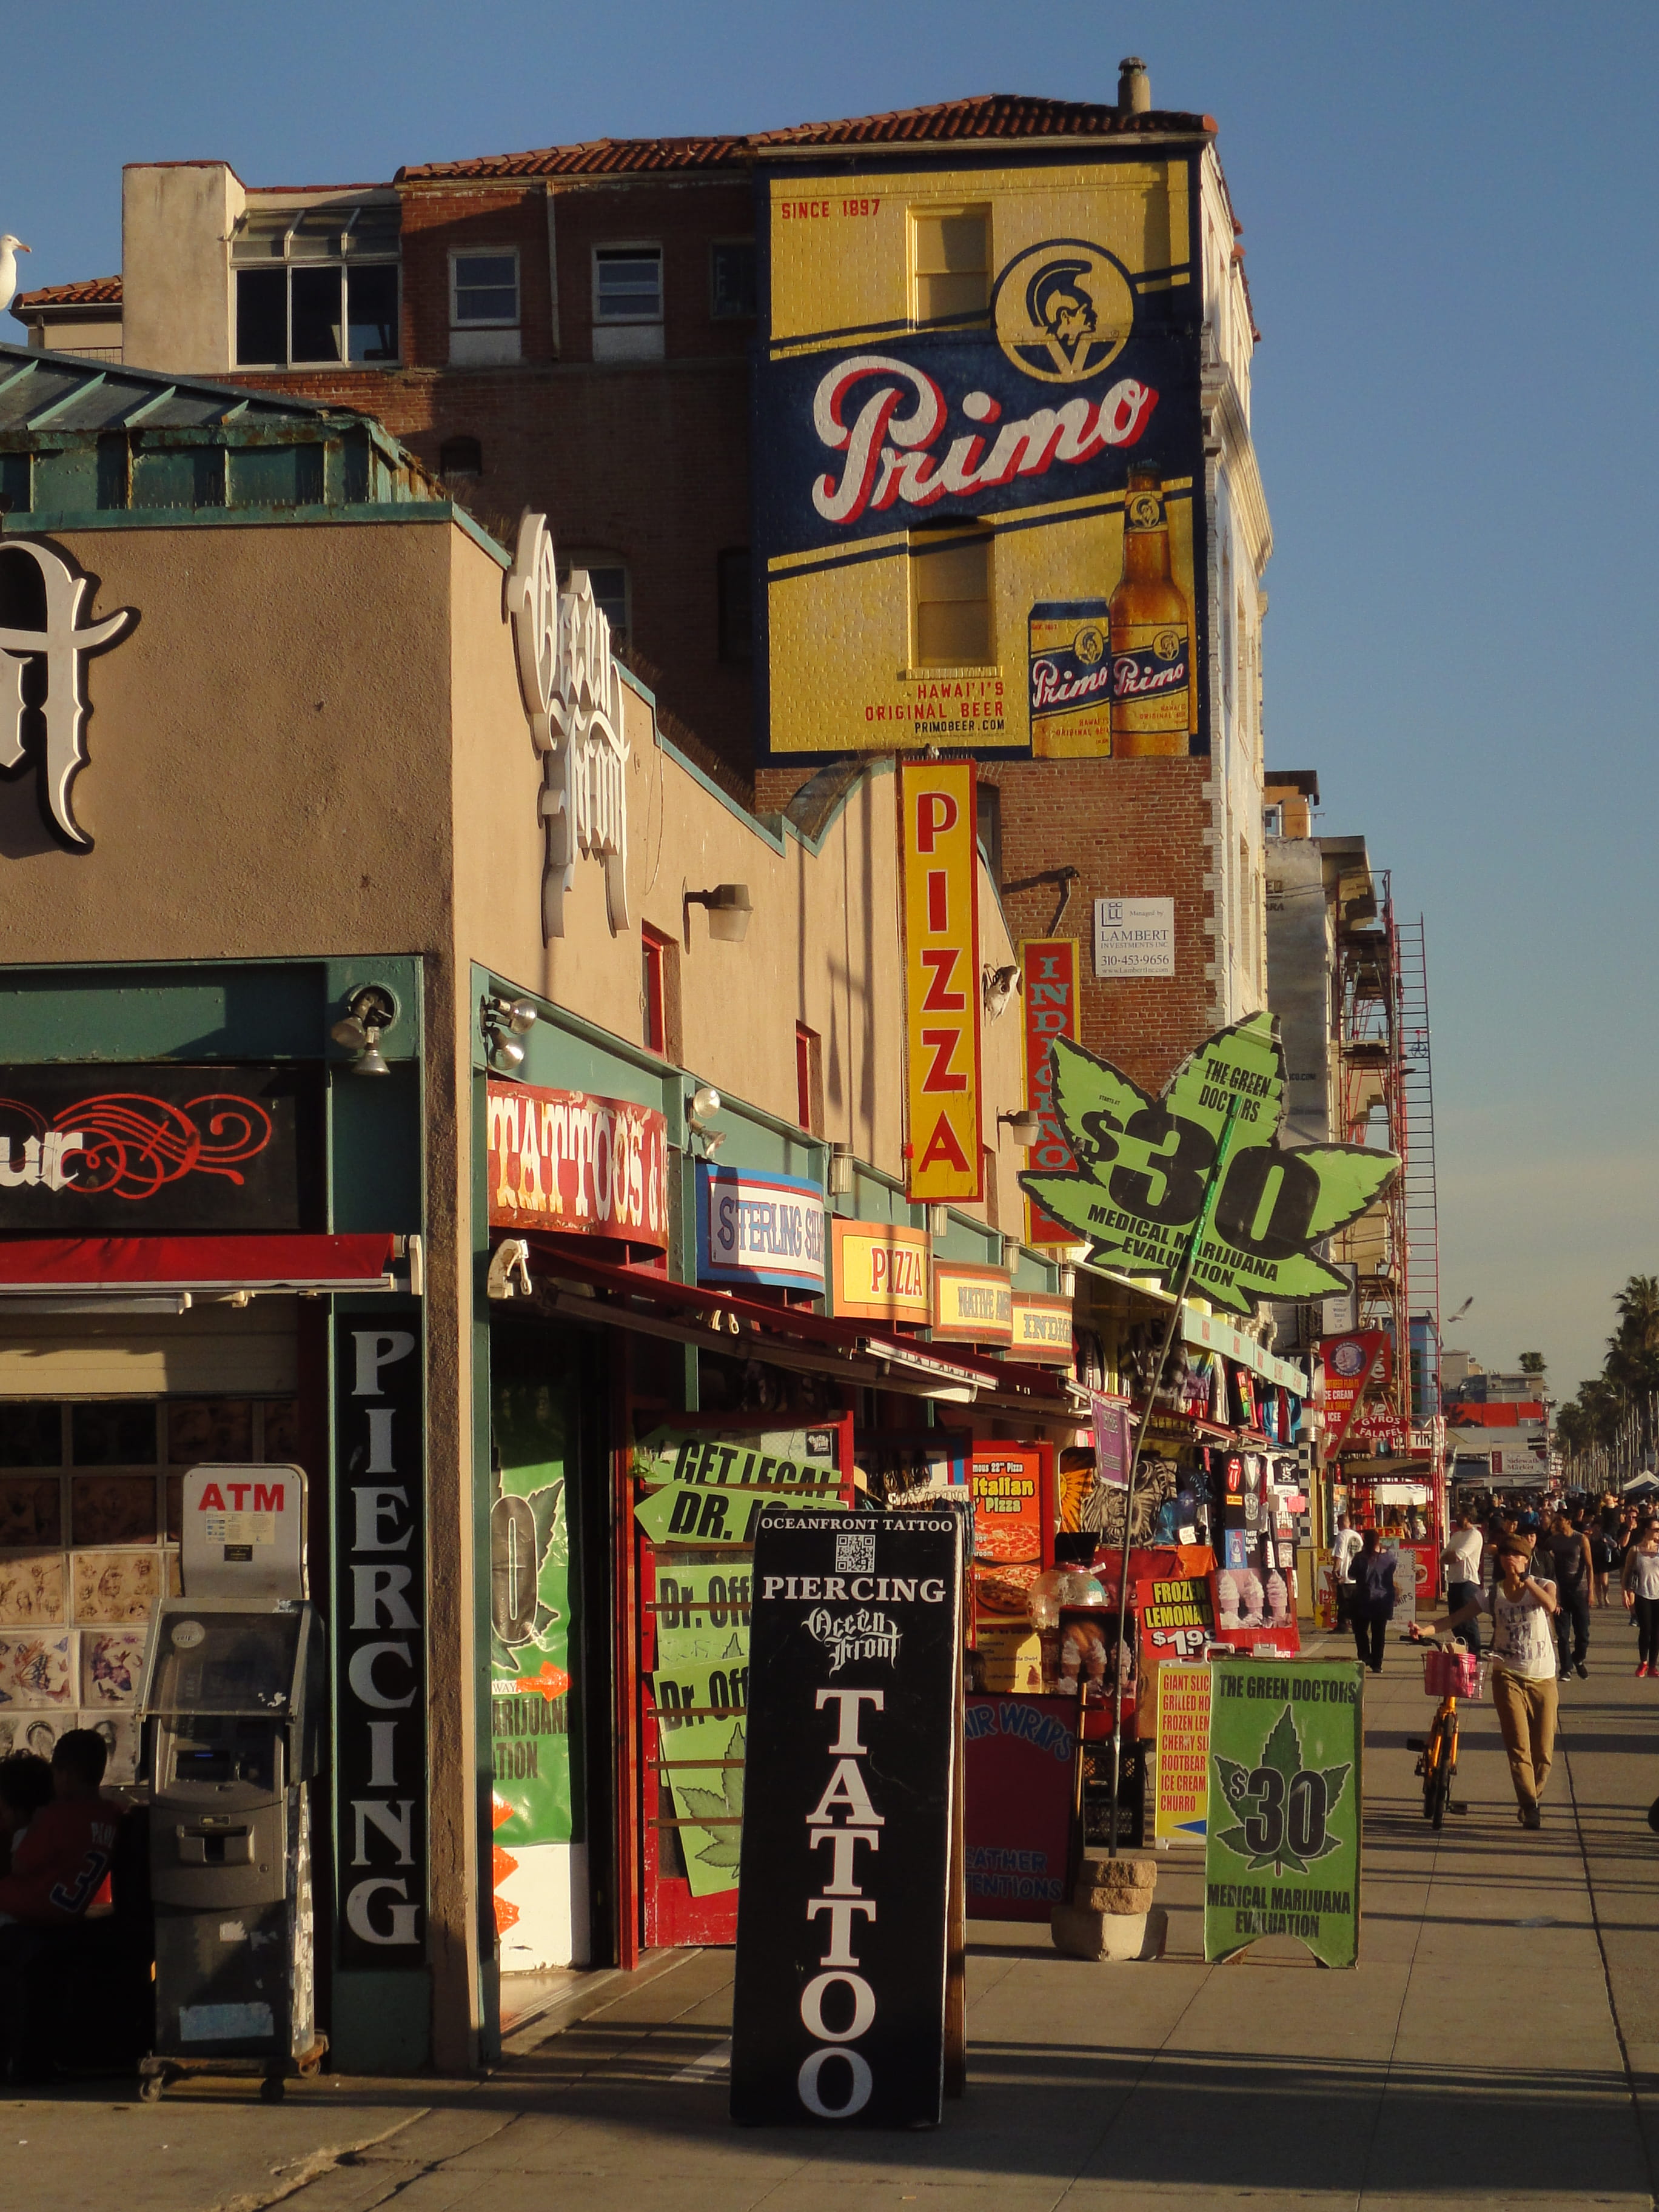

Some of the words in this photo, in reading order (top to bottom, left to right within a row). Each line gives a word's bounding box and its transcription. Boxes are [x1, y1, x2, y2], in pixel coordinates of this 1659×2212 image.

[782, 201, 829, 220] SINCE
[843, 199, 880, 216] 1897
[813, 355, 1159, 525] Primo
[1033, 659, 1108, 708] Primo
[1113, 657, 1185, 696] Primo
[865, 703, 947, 722] ORIGINAL
[961, 701, 1004, 718] BEER
[914, 719, 1005, 733] PRIMOBEER.COM
[1101, 930, 1169, 942] LAMBERT
[916, 793, 971, 1173] PIZZA
[1205, 1058, 1230, 1085] THE
[1229, 1067, 1272, 1098] GREEN
[1099, 1095, 1114, 1104] STARTS
[1198, 1084, 1261, 1122] DOCTRS
[487, 1096, 643, 1227] TATTOOS
[1081, 1108, 1322, 1261] $30
[717, 1196, 802, 1258] STERLING
[1088, 1204, 1170, 1243] MEDICAL
[871, 1247, 923, 1297] PIZZA
[1122, 1236, 1235, 1288] EVALUTION
[957, 1286, 994, 1319] NATIVE
[1023, 1313, 1072, 1344] INDIG
[1333, 1389, 1354, 1400] CREAM
[1327, 1412, 1342, 1422] ICEE
[1361, 1416, 1401, 1426] GYROS
[1359, 1426, 1403, 1438] FALAFEL
[674, 1439, 739, 1484] GET
[972, 1463, 990, 1473] mous
[1007, 1462, 1024, 1473] Pizza
[198, 1483, 284, 1512] ATM
[973, 1476, 1034, 1496] Italian
[668, 1490, 732, 1540] DR.
[979, 1497, 1021, 1512] Pizza
[760, 1518, 877, 1530] OCEANFRONT
[883, 1519, 953, 1532] TATTOO
[660, 1578, 702, 1629] Dr.
[708, 1576, 752, 1629] Off
[762, 1577, 946, 1603] PIERCING
[1153, 1581, 1206, 1603] FROZEN
[1145, 1604, 1213, 1628] LEMONAD
[346, 1331, 421, 1945] PIERCING
[1153, 1629, 1216, 1655] $1.99
[493, 1683, 516, 1693] WAY
[709, 1666, 749, 1721] Off
[1164, 1675, 1189, 1691] GIANT
[1191, 1675, 1209, 1692] SLIC
[1219, 1675, 1243, 1697] THE
[1247, 1676, 1289, 1700] GREEN
[1292, 1678, 1357, 1704] DOCTORS
[1163, 1695, 1196, 1712] GRILLED
[1199, 1695, 1210, 1712] HO
[999, 1701, 1074, 1761] WRAPS
[1162, 1715, 1193, 1731] FROZEN
[1161, 1755, 1206, 1772] ROOTBEAR
[1161, 1774, 1175, 1791] ICE
[1177, 1775, 1206, 1792] CREAM
[1160, 1794, 1196, 1812] CHURRO
[1230, 1765, 1327, 1857] $30
[965, 1848, 1047, 1873] EATHER
[965, 1872, 1063, 1903] ENTIONS
[1207, 1884, 1267, 1909] MEDICAL
[1271, 1887, 1351, 1914] MARIJUANA
[797, 1689, 885, 2118] TATTOO
[1235, 1911, 1319, 1938] EVALUATION
